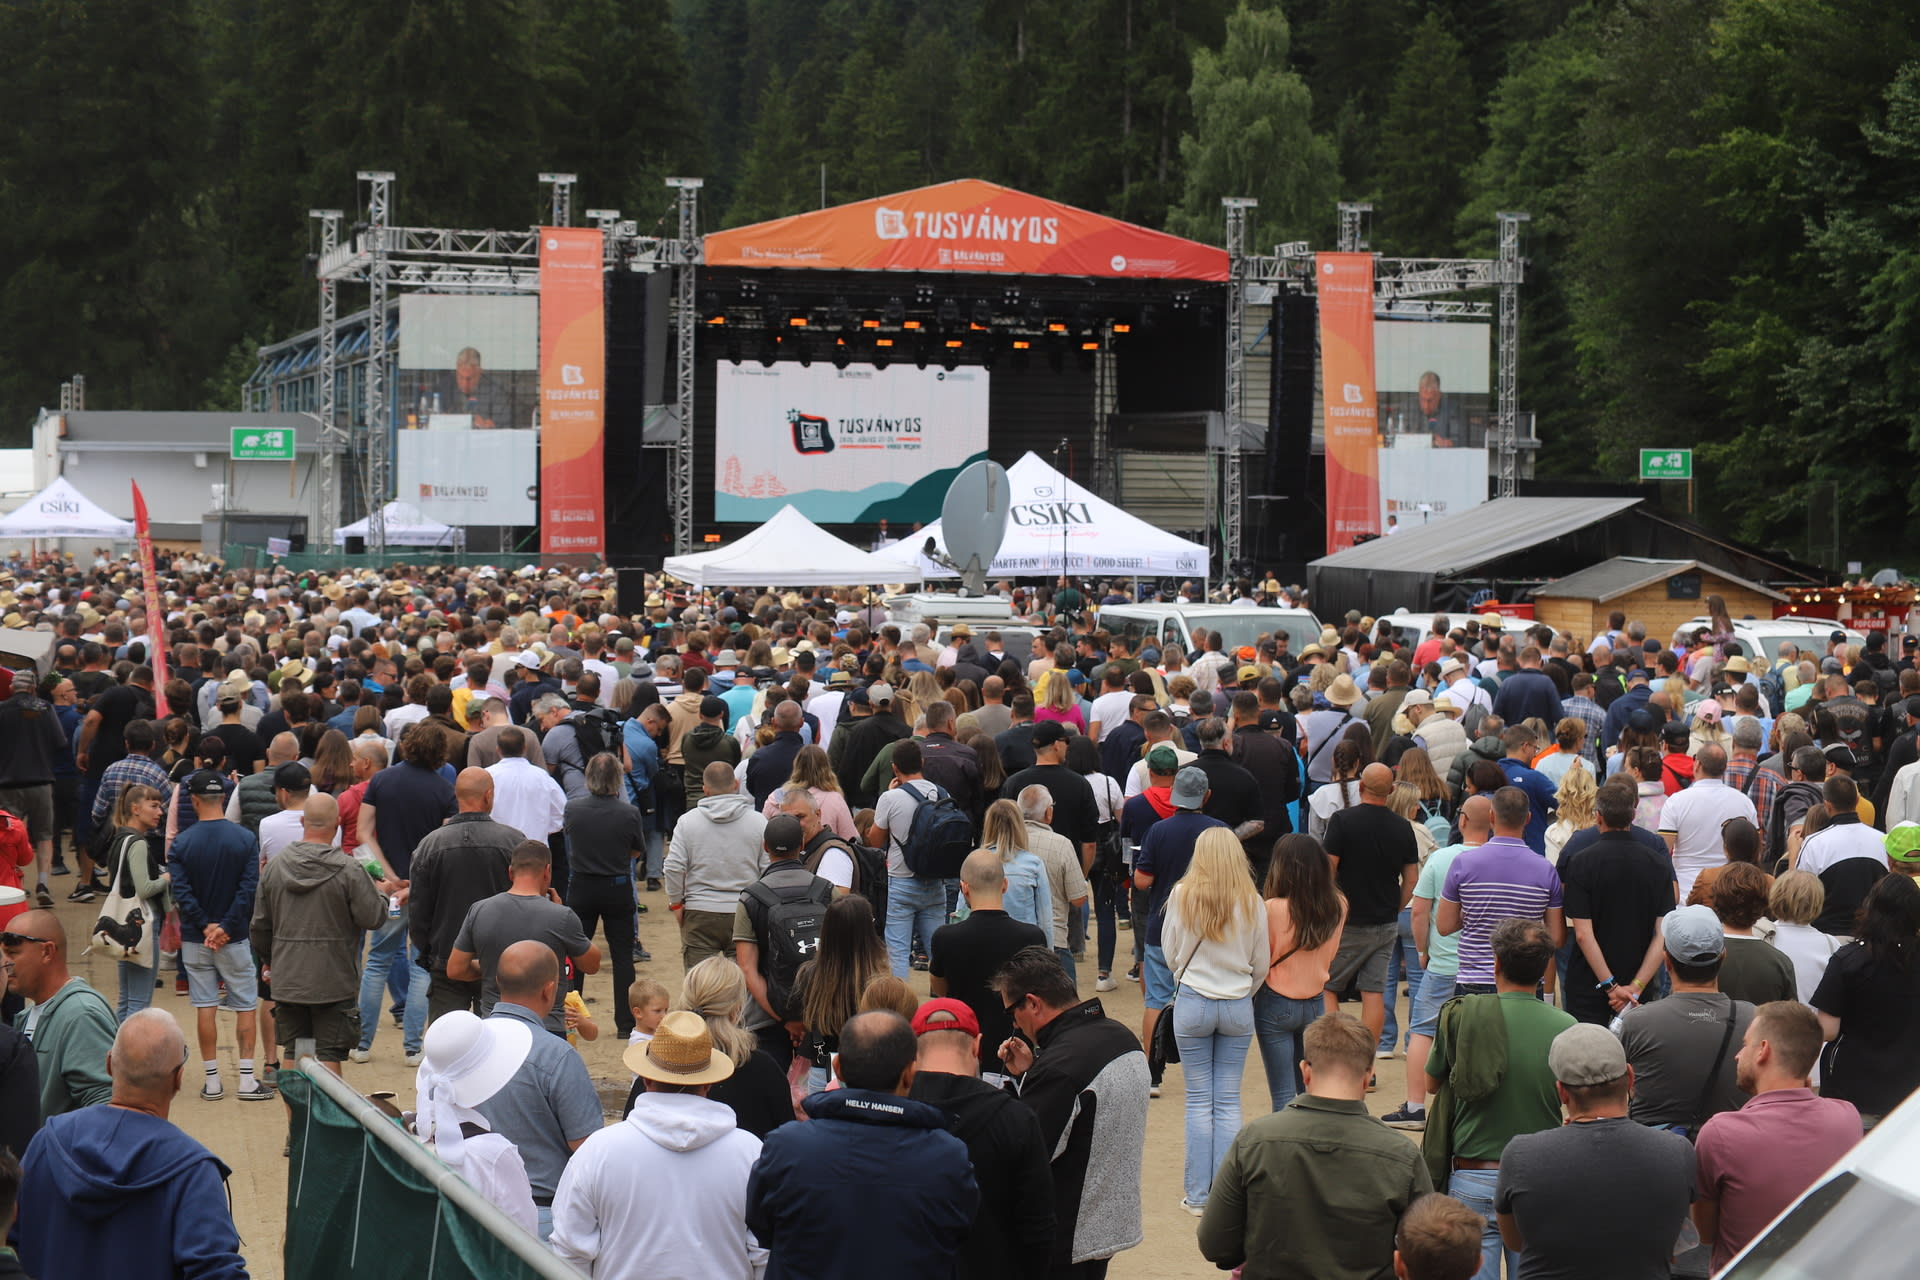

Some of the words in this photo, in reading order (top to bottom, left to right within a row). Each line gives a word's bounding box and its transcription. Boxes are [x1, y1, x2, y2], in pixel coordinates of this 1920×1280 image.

[913, 207, 1059, 245] TUSVÁNYOS
[839, 414, 922, 434] TUSVÁNYOS
[992, 558, 1018, 569] OARTE
[1853, 620, 1886, 629] POPCORN
[845, 1098, 870, 1109] HELLY
[871, 1102, 904, 1114] HANSEN
